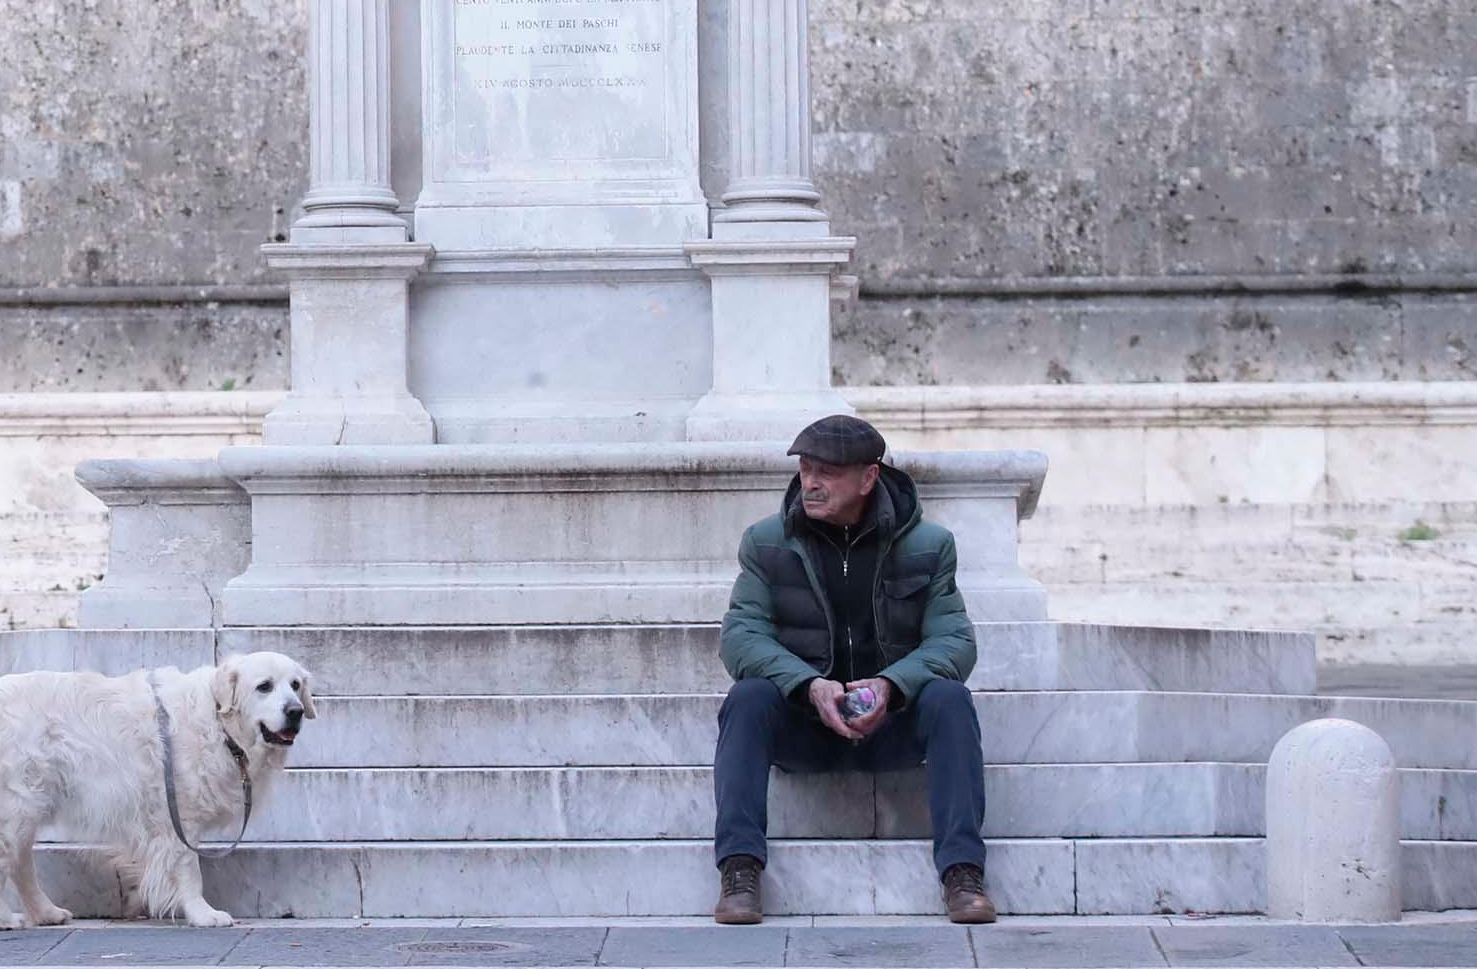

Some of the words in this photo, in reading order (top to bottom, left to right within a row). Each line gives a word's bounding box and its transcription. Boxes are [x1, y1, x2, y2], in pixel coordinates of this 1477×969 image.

[516, 19, 552, 29] MONTE
[558, 19, 576, 29] DEI
[582, 18, 619, 28] PASCHI
